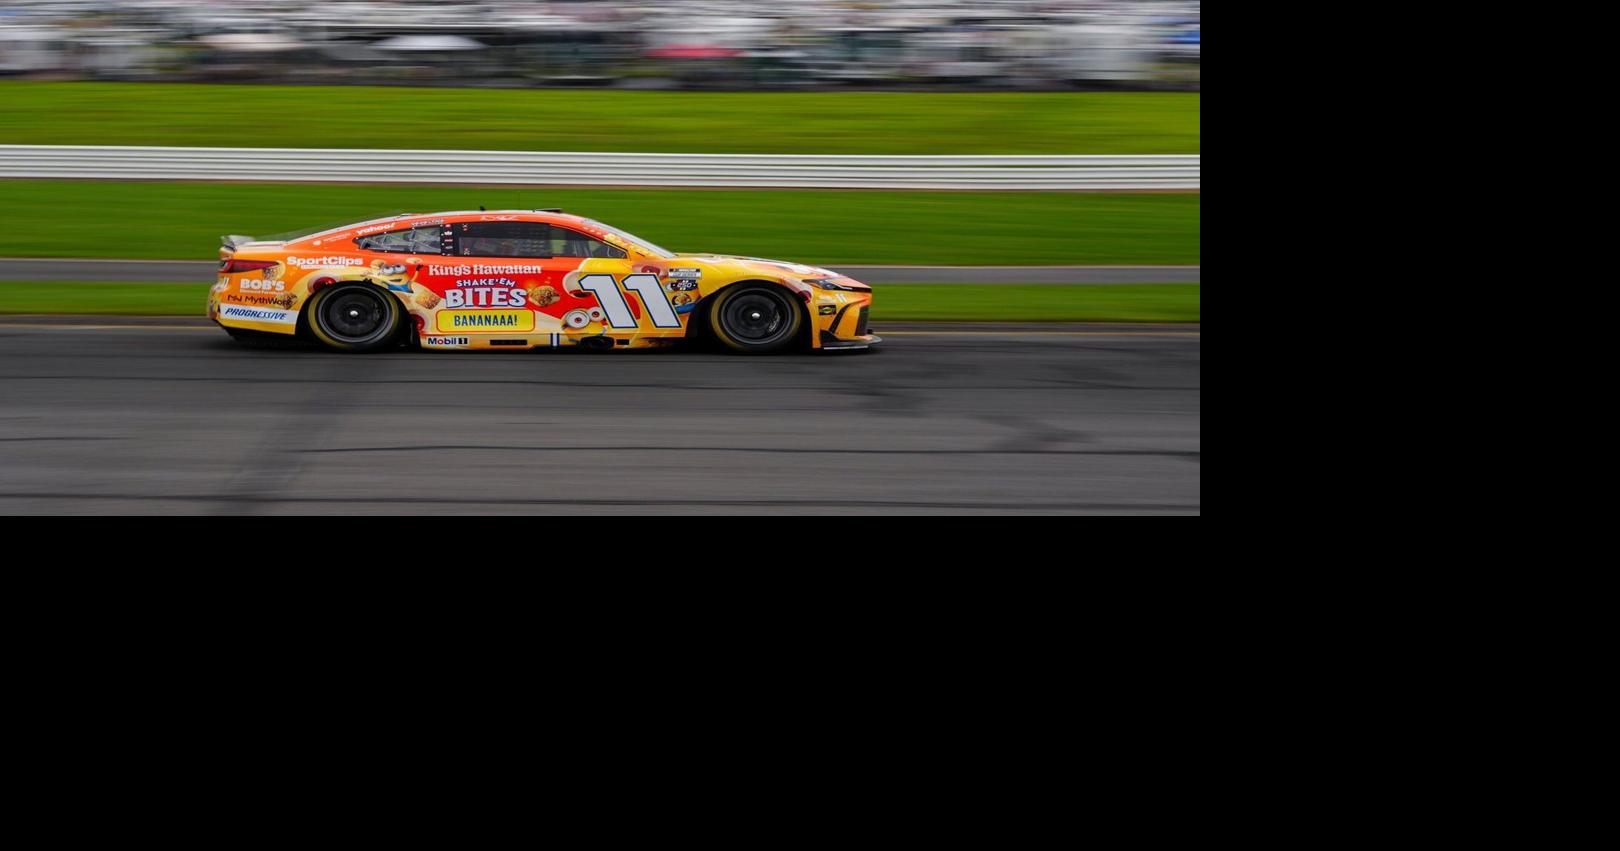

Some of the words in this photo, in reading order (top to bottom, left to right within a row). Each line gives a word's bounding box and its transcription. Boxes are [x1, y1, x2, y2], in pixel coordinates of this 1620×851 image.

[356, 223, 396, 235] yahoo!
[287, 256, 364, 267] SportClips
[428, 264, 470, 276] King's
[473, 264, 542, 275] Hawaiian
[240, 278, 285, 291] BOB'S
[445, 288, 527, 308] BITES
[578, 274, 682, 328] 11
[225, 307, 287, 320] PROGRESSIVE
[454, 315, 518, 326] BANANAAA!
[427, 337, 457, 345] Mobil
